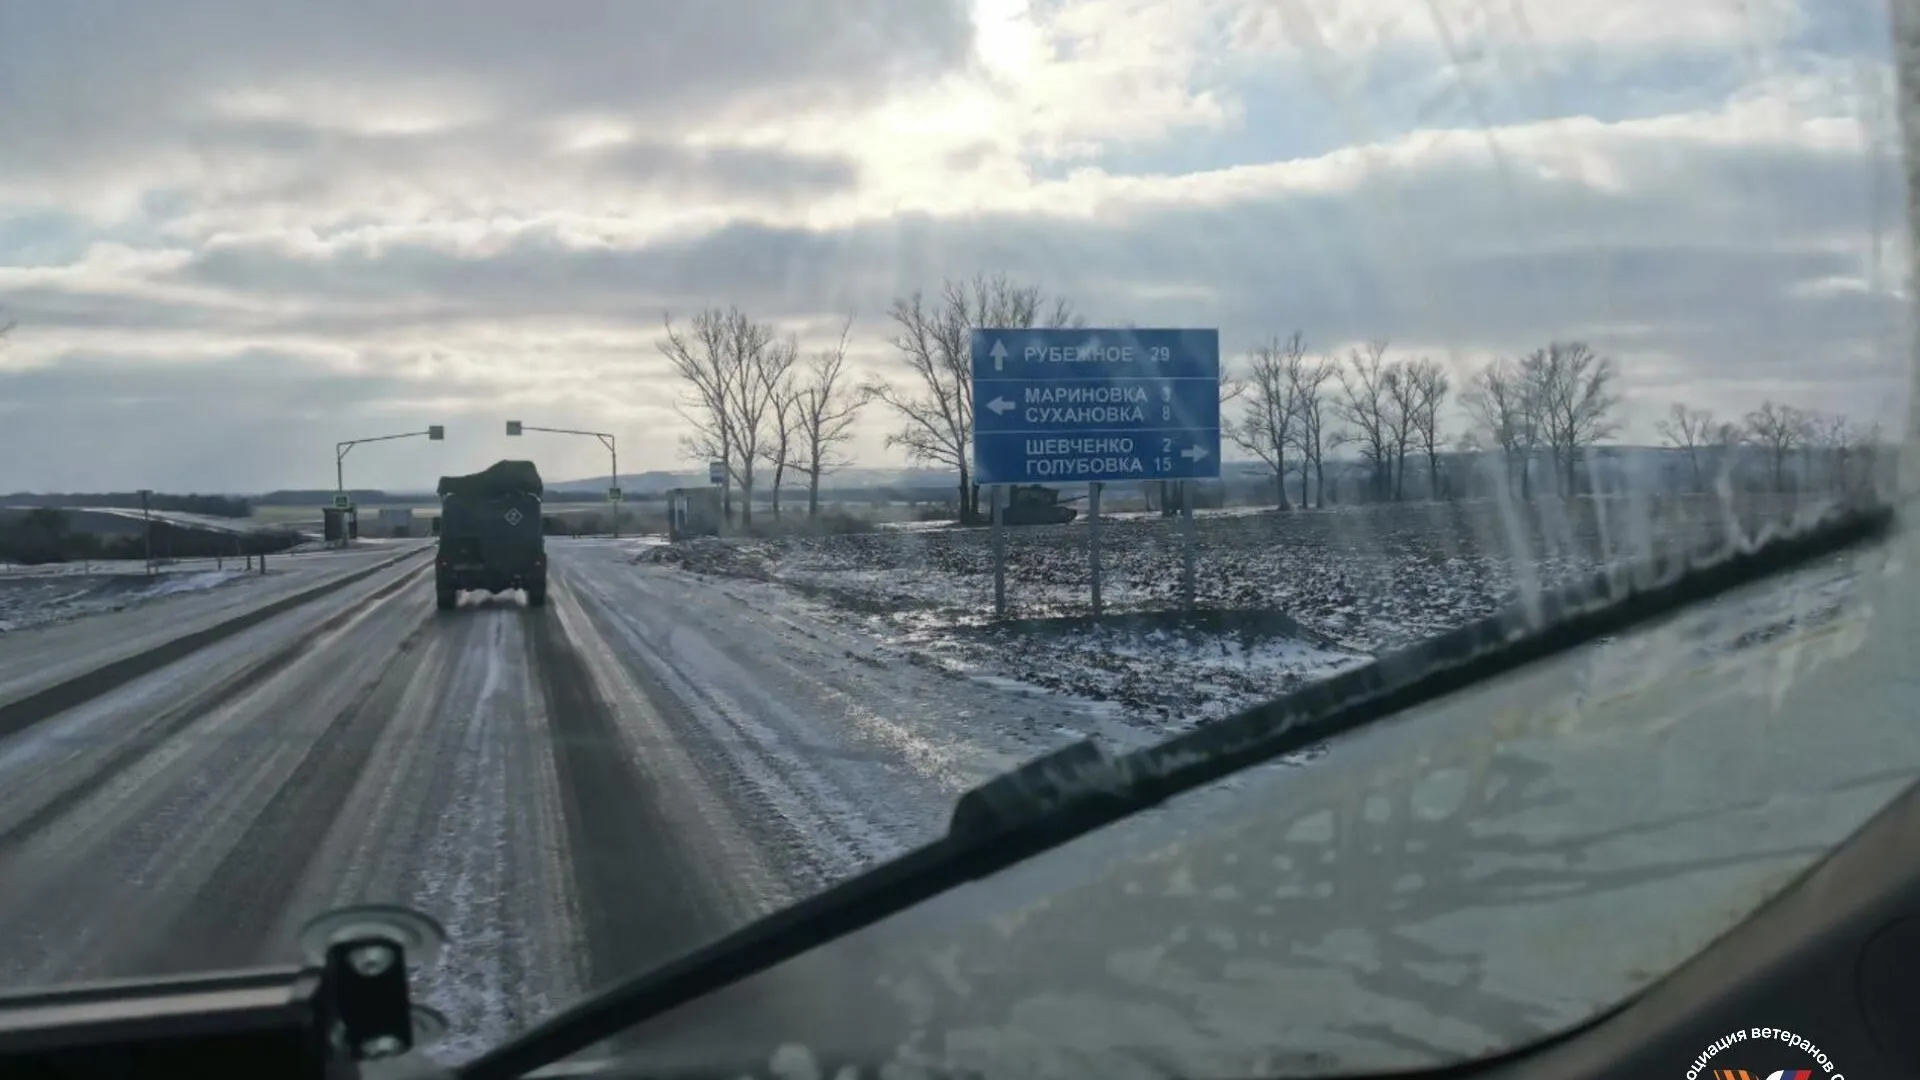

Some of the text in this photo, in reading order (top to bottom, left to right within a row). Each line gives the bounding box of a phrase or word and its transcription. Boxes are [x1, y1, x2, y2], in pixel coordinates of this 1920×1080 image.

[1024, 346, 1170, 362] РУБЕЖНОЕ 29
[1025, 387, 1171, 403] МАРИНОВКА 3
[1025, 406, 1171, 423] СУХАНОВКА 8
[1026, 438, 1172, 455] ШЕВЧЕНКО 2
[1026, 457, 1172, 475] ГОЛУБОВКА 15
